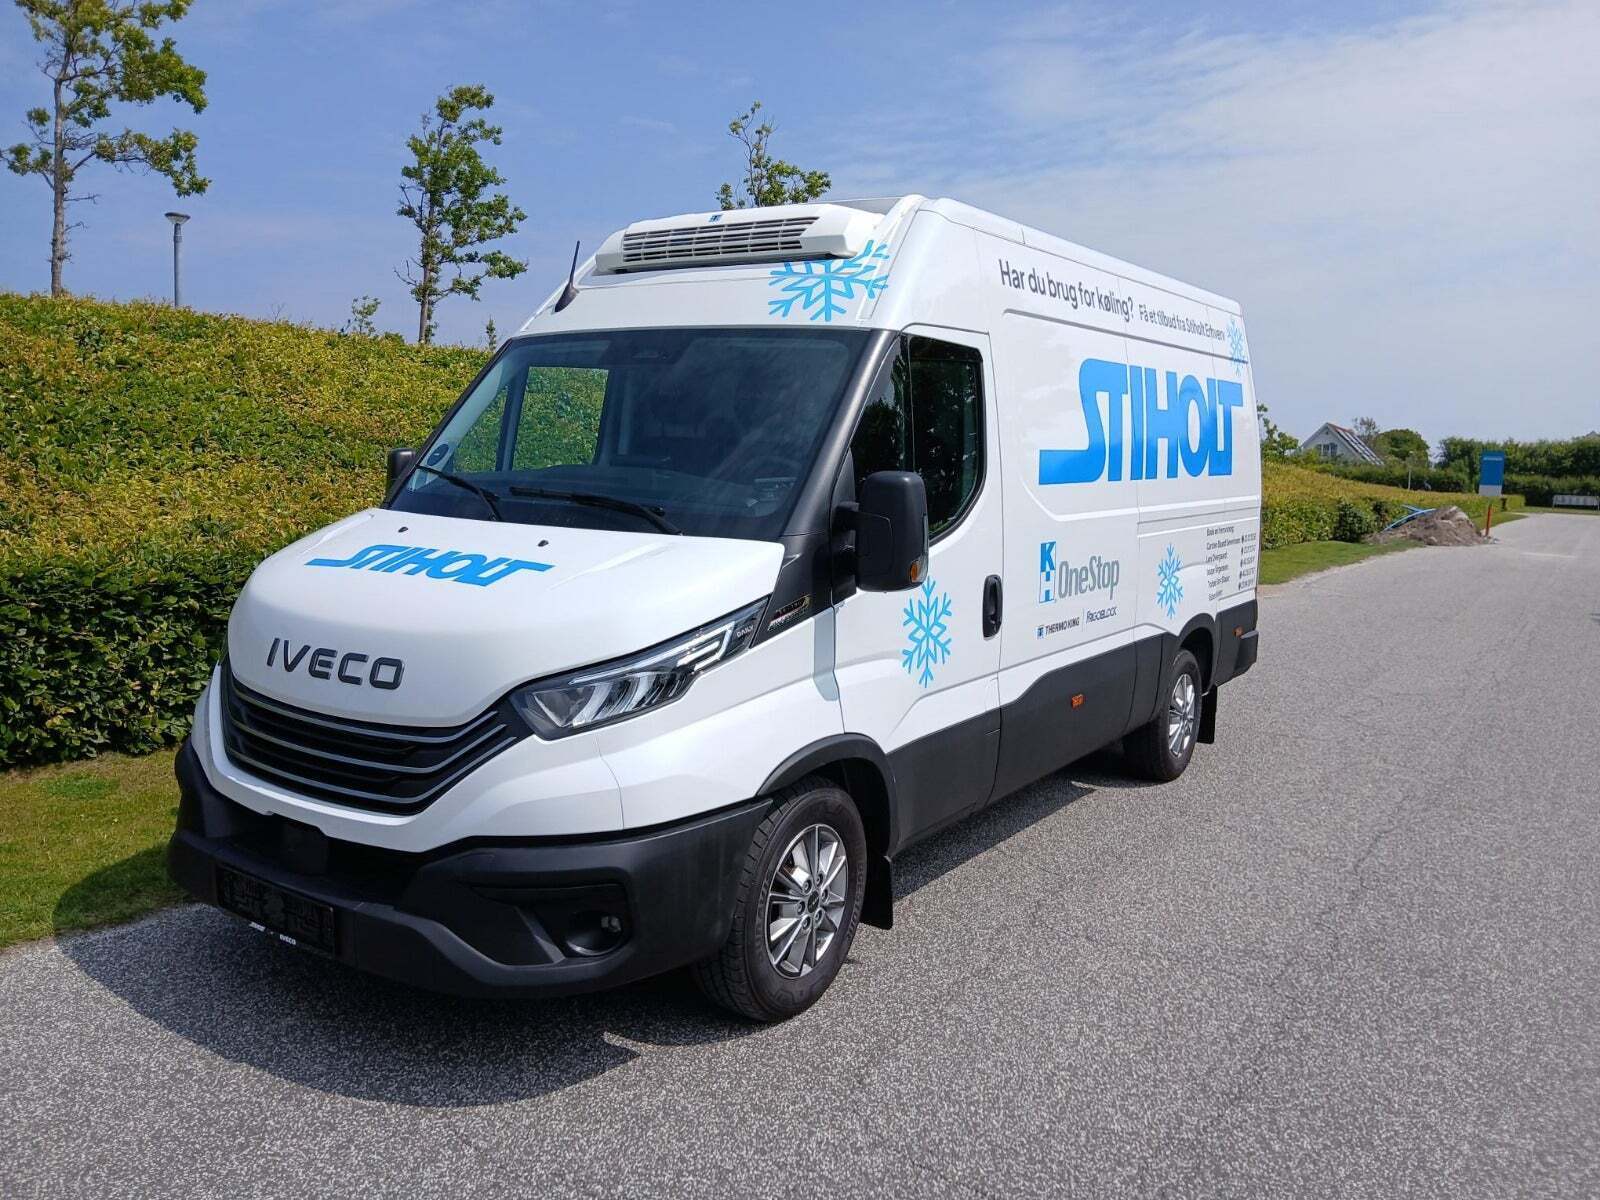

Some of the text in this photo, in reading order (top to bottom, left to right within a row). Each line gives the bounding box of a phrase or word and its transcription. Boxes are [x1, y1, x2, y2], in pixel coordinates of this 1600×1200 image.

[999, 259, 1134, 323] Har du brug for køling?
[1139, 304, 1148, 322] Få
[1149, 310, 1157, 323] et
[1157, 309, 1177, 330] tilbud
[1039, 358, 1243, 485] STIHOLT
[304, 544, 555, 587] STIHOLT
[1058, 555, 1119, 600] OneStop
[1045, 617, 1080, 636] THERMO KING
[267, 638, 405, 690] IVECO
